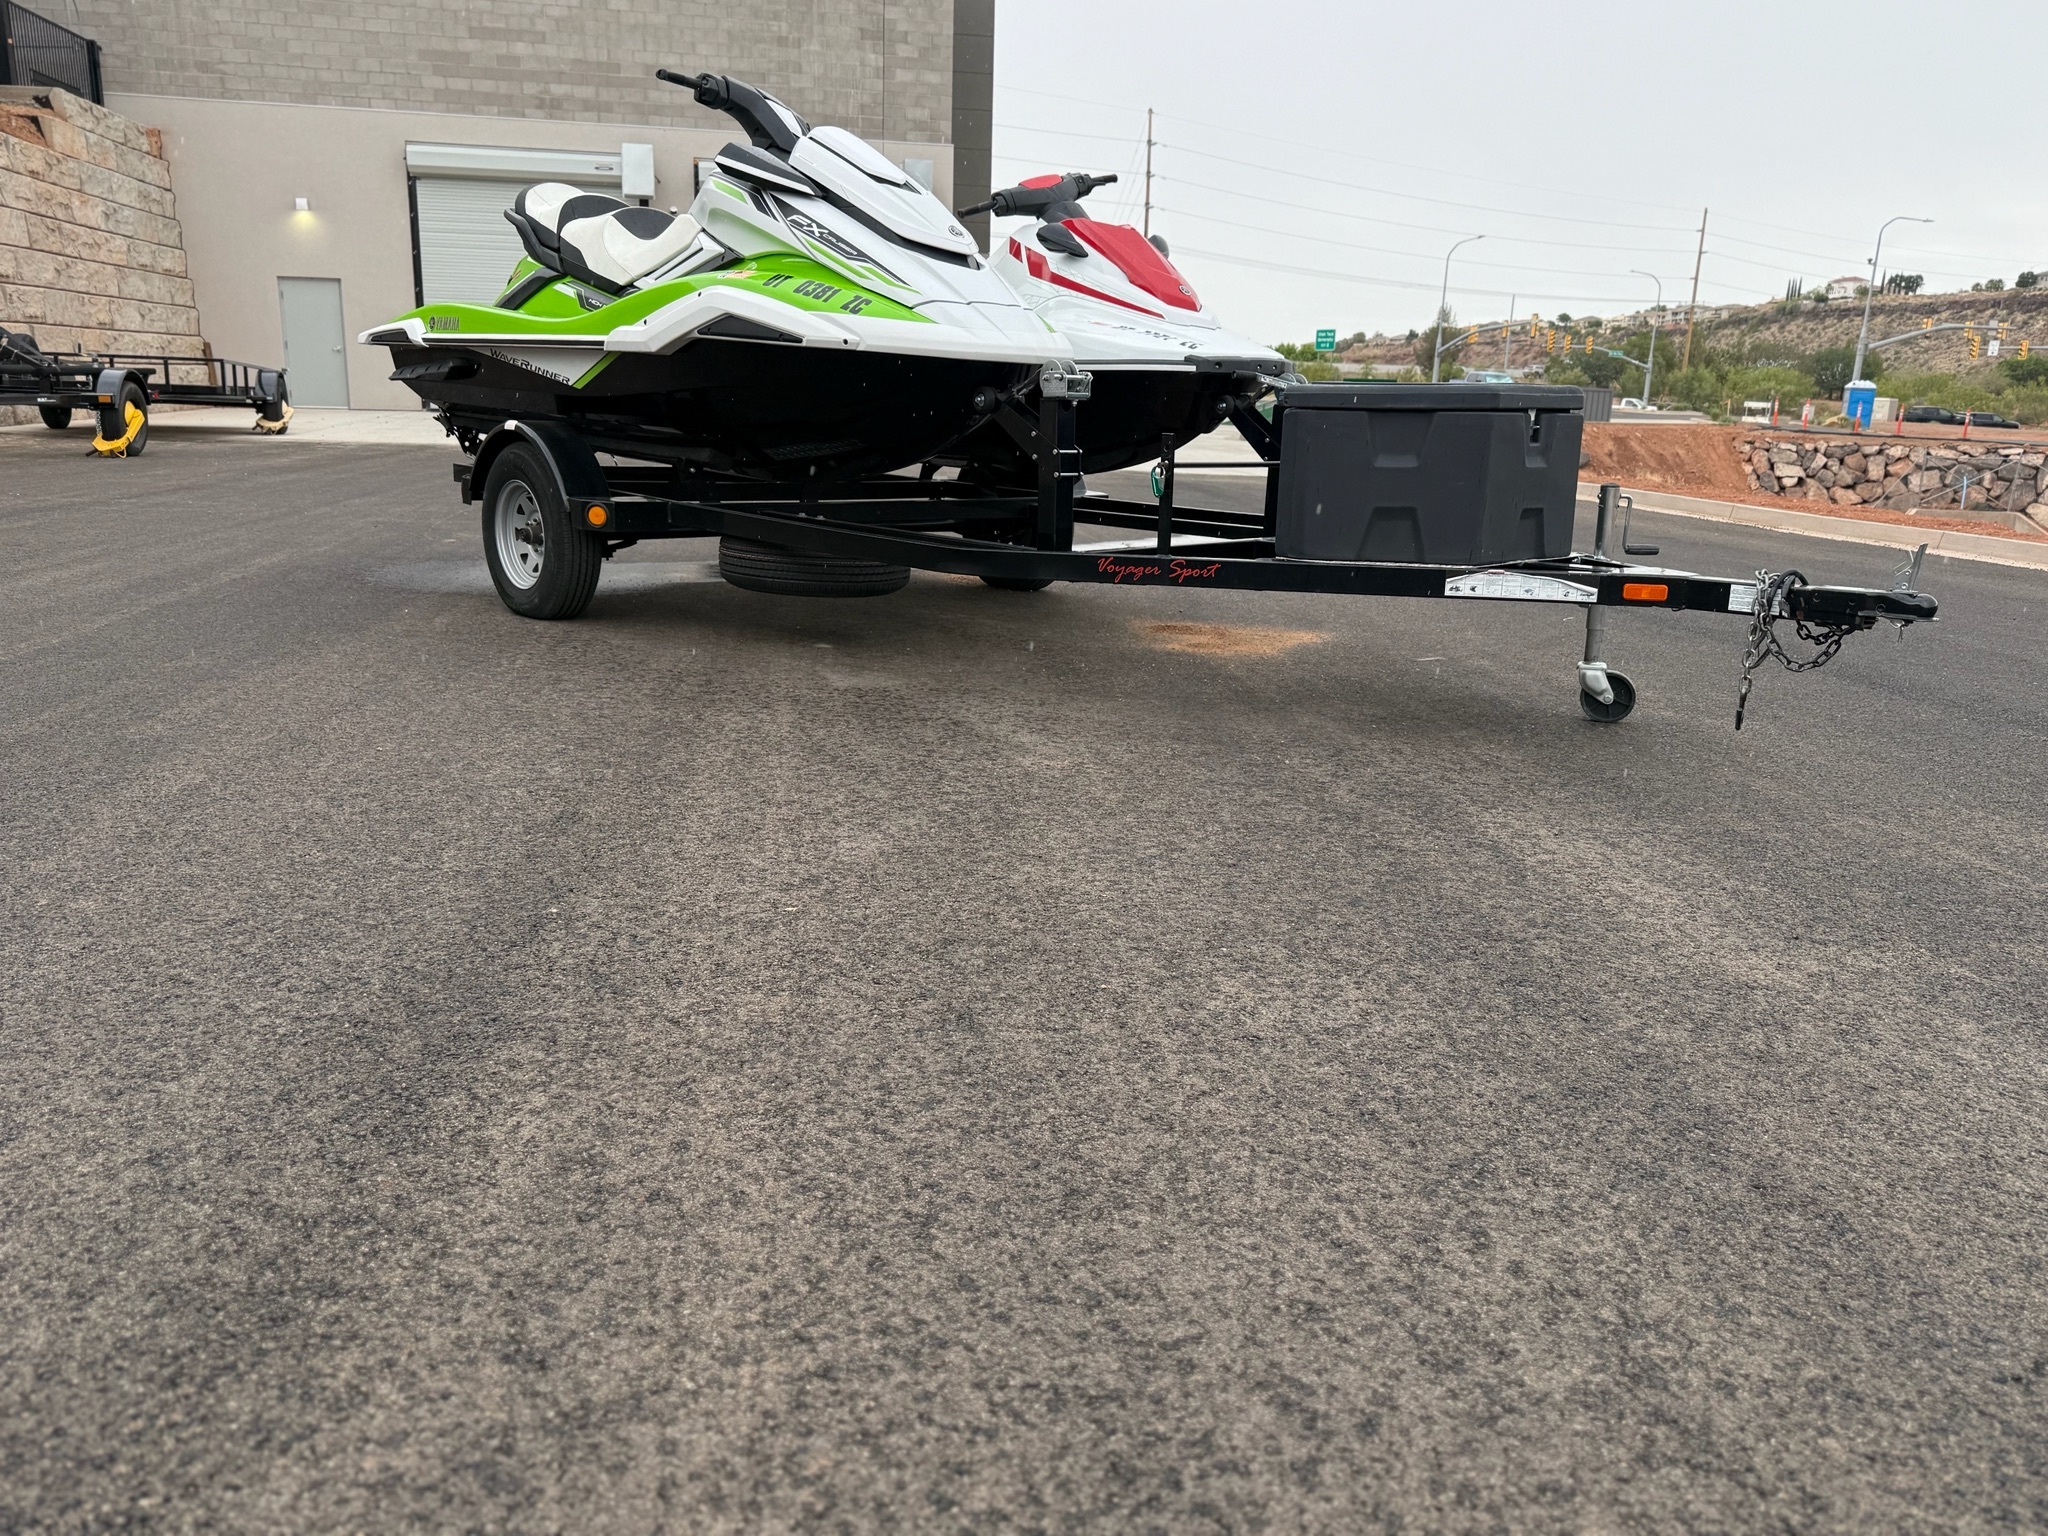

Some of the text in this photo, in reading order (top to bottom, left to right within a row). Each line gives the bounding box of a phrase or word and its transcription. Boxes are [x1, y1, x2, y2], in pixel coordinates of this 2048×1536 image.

[787, 214, 829, 237] FX
[762, 273, 794, 288] UT
[792, 280, 842, 303] 0381
[840, 295, 873, 315] ZC
[436, 316, 460, 331] YAMAHA
[1097, 556, 1221, 583] Voyager Sport
